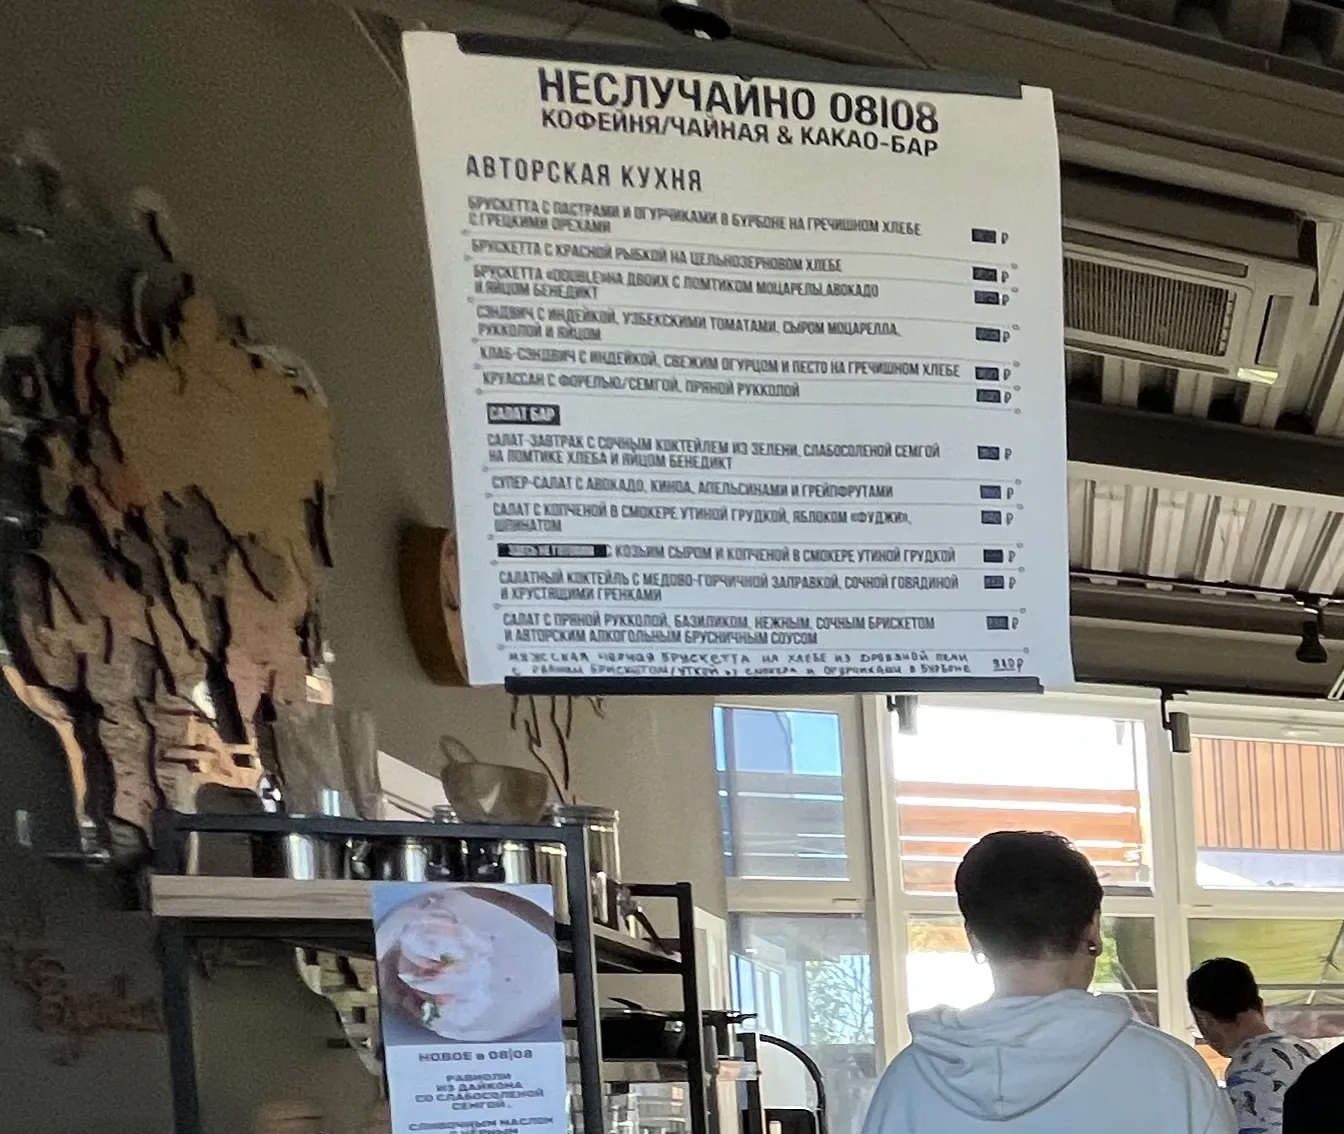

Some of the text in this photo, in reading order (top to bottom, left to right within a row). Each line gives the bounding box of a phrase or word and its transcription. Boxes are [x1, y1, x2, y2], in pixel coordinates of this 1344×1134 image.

[538, 66, 815, 123] НЕСЛУЧАЙНО
[541, 105, 937, 157] КОФЕЙНЯ/ЧАЙНАЯ & КАКАО-БАР
[466, 154, 701, 192] АВТОРСКАЯ КУХНЯ
